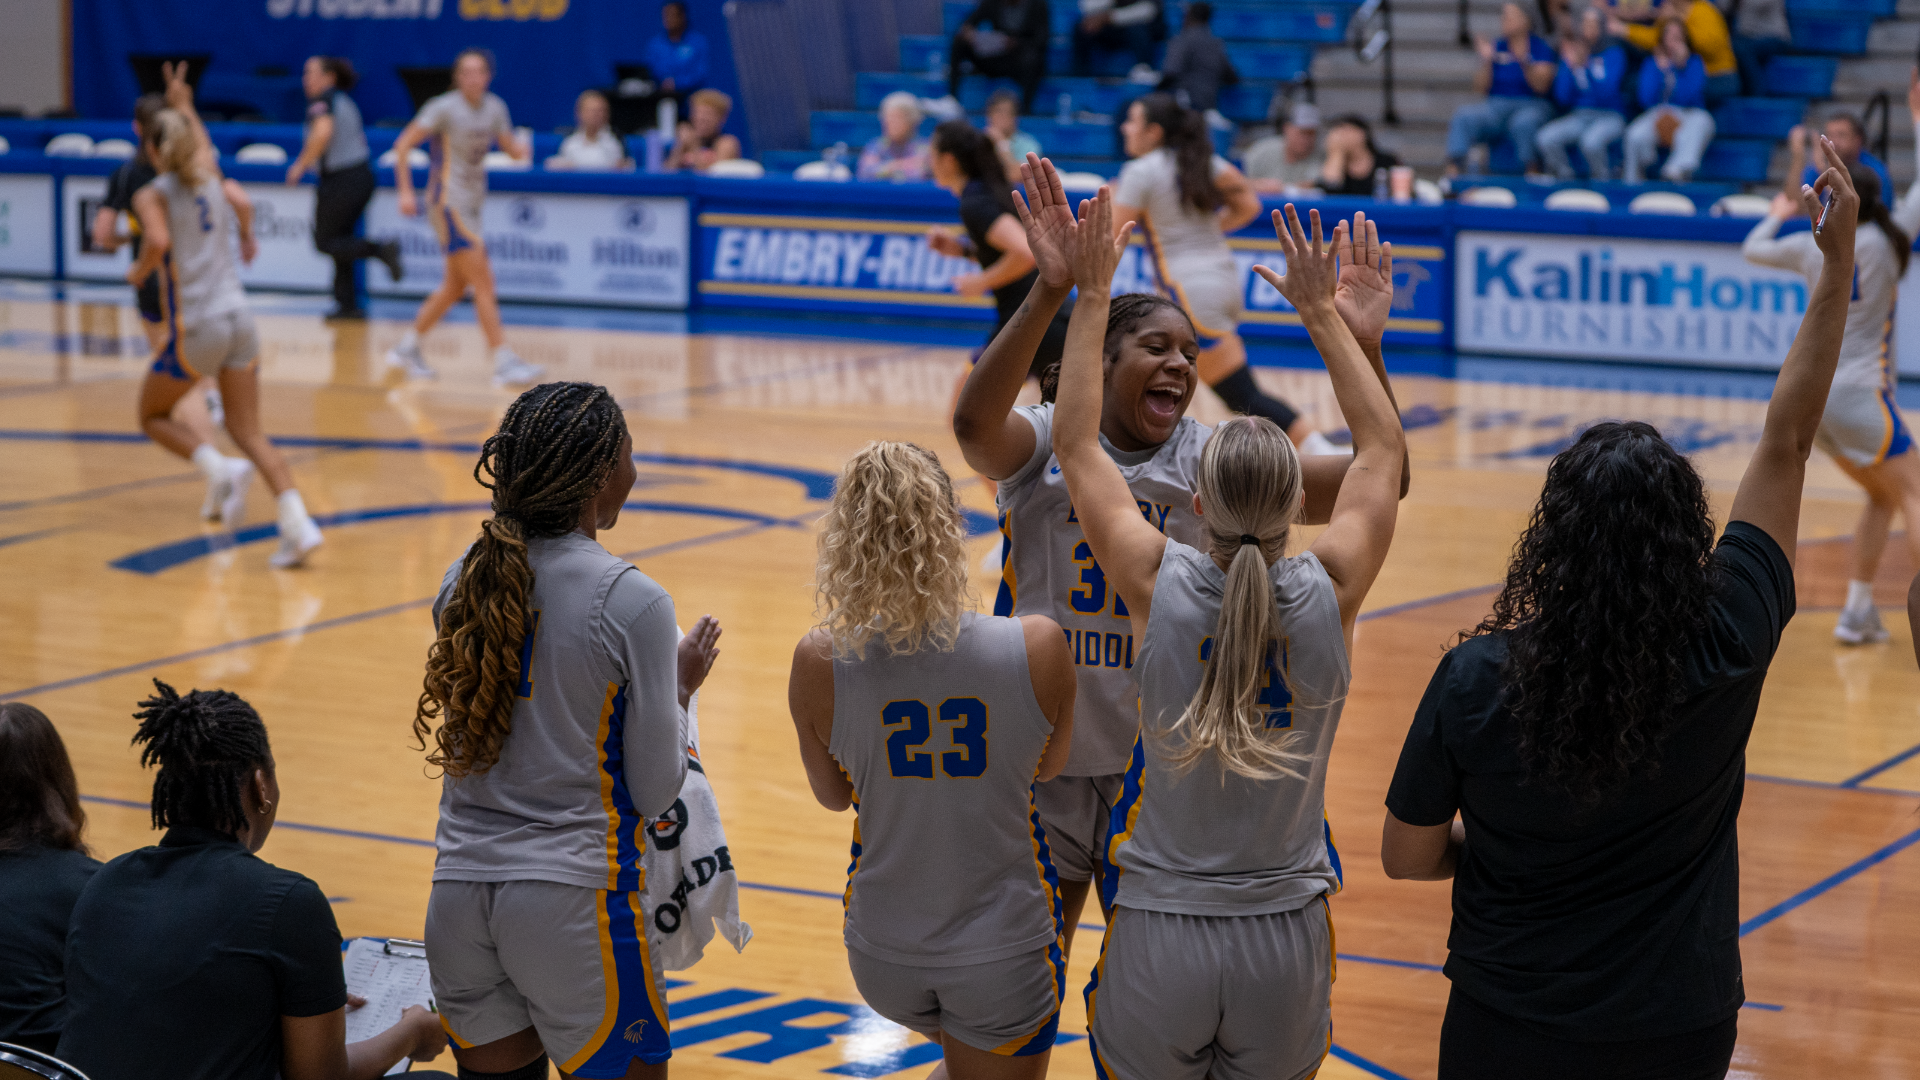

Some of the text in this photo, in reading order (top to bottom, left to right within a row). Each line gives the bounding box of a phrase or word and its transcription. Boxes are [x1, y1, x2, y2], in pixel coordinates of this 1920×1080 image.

[591, 234, 681, 268] Hilton
[1474, 246, 1807, 315] KalinHom
[1068, 539, 1131, 619] 3
[880, 696, 989, 780] 23
